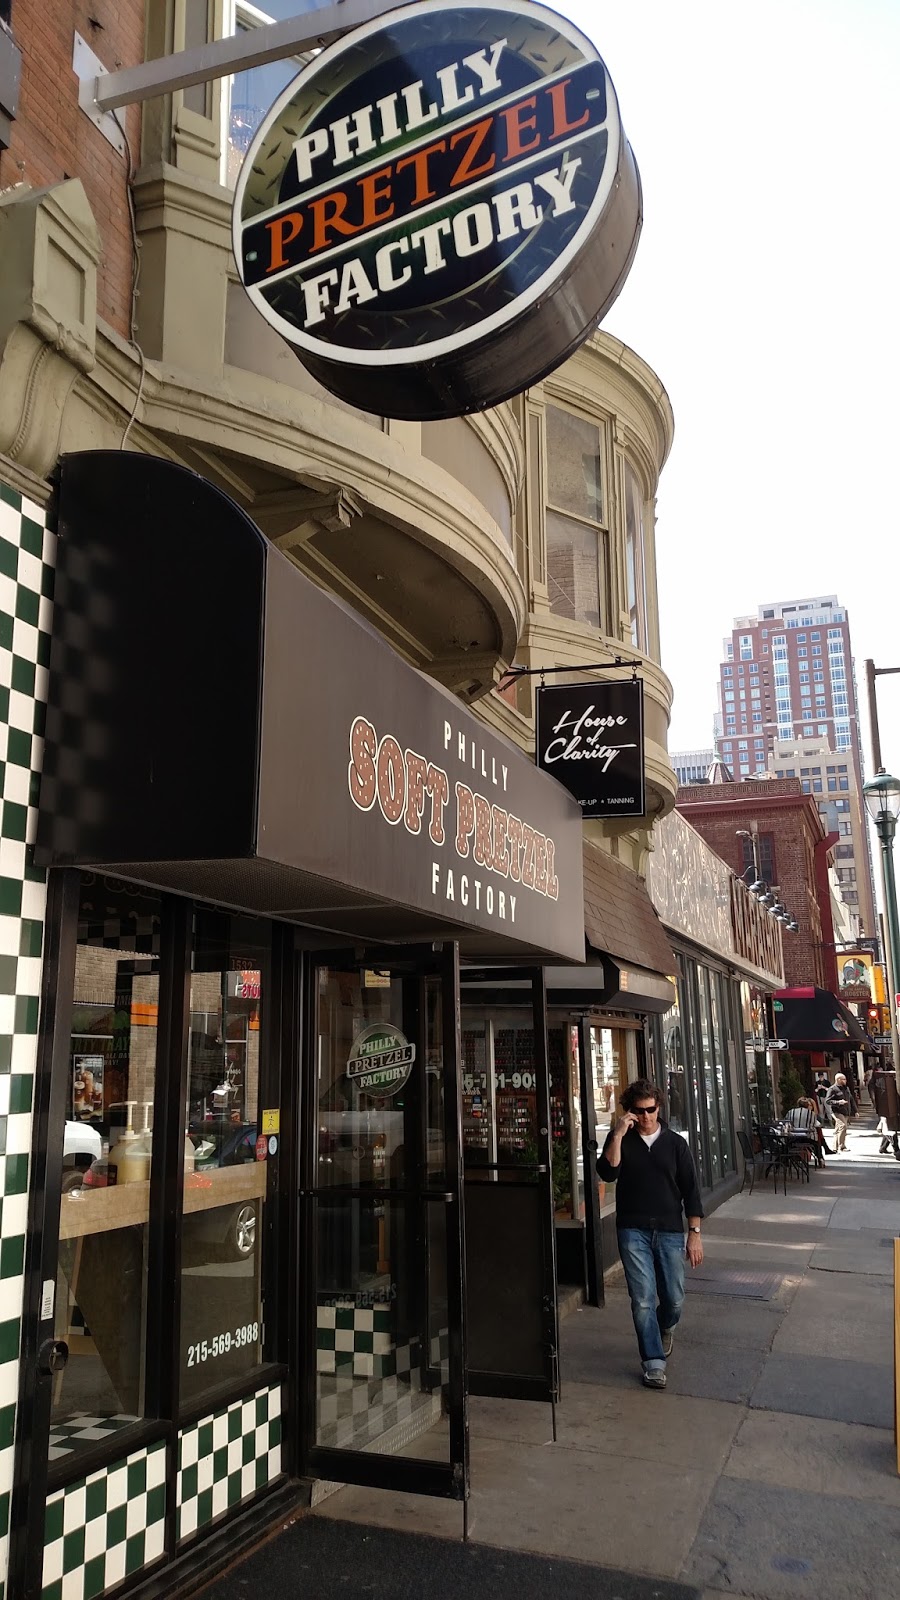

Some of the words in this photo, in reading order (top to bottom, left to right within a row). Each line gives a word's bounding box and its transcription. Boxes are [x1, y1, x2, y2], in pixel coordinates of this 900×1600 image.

[292, 38, 509, 183] PHILLY
[265, 79, 590, 273] PRETZEL
[301, 158, 582, 328] FACTORY
[552, 705, 628, 735] House
[578, 728, 599, 746] of
[349, 716, 449, 846] SOFT
[444, 720, 508, 791] PHILLY
[544, 736, 637, 773] Clarity
[455, 782, 559, 901] PRETZEL
[432, 862, 517, 923] FACTORY
[354, 1048, 409, 1073] PRETZEL
[359, 1035, 397, 1055] PHILLY
[360, 1065, 408, 1088] FACTORY
[187, 1321, 258, 1367] 215-569-3988
